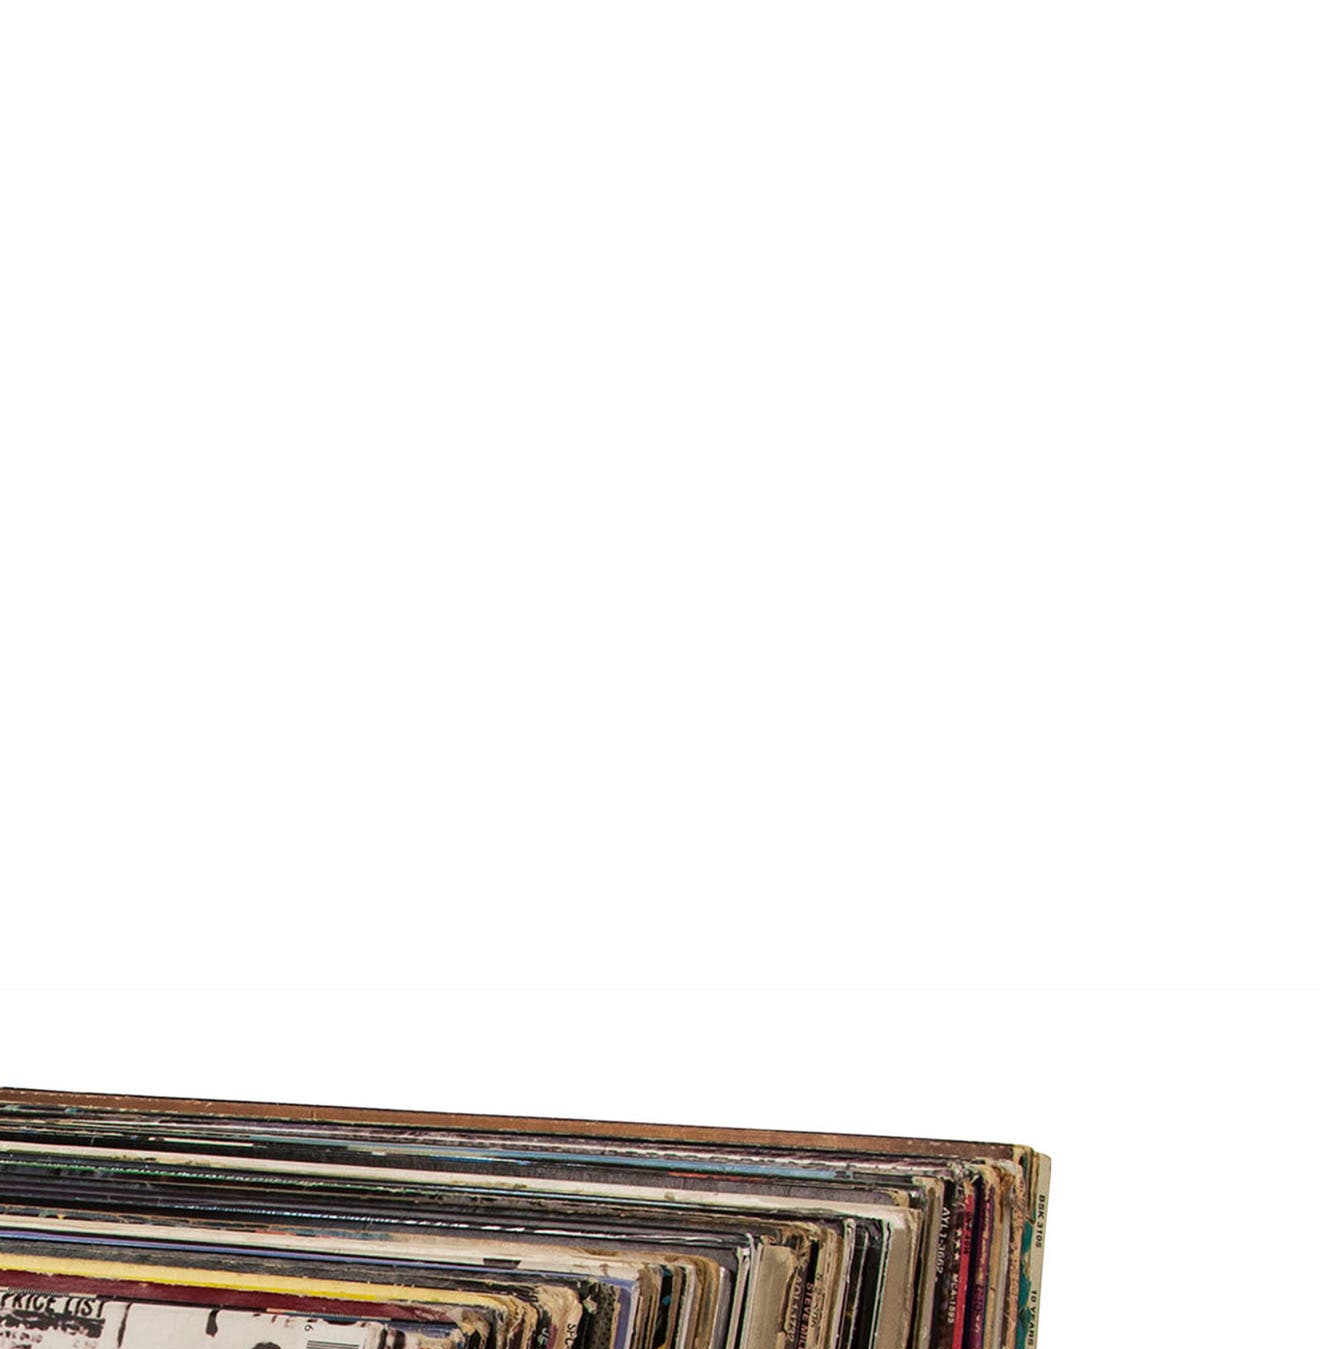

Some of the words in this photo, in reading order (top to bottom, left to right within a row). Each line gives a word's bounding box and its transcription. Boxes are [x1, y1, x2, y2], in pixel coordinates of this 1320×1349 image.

[1037, 1194, 1045, 1218] BSK
[1035, 1221, 1043, 1248] 3105
[64, 1296, 107, 1318] LIST
[800, 1282, 813, 1320] STEVE
[1027, 1306, 1037, 1346] YEARS
